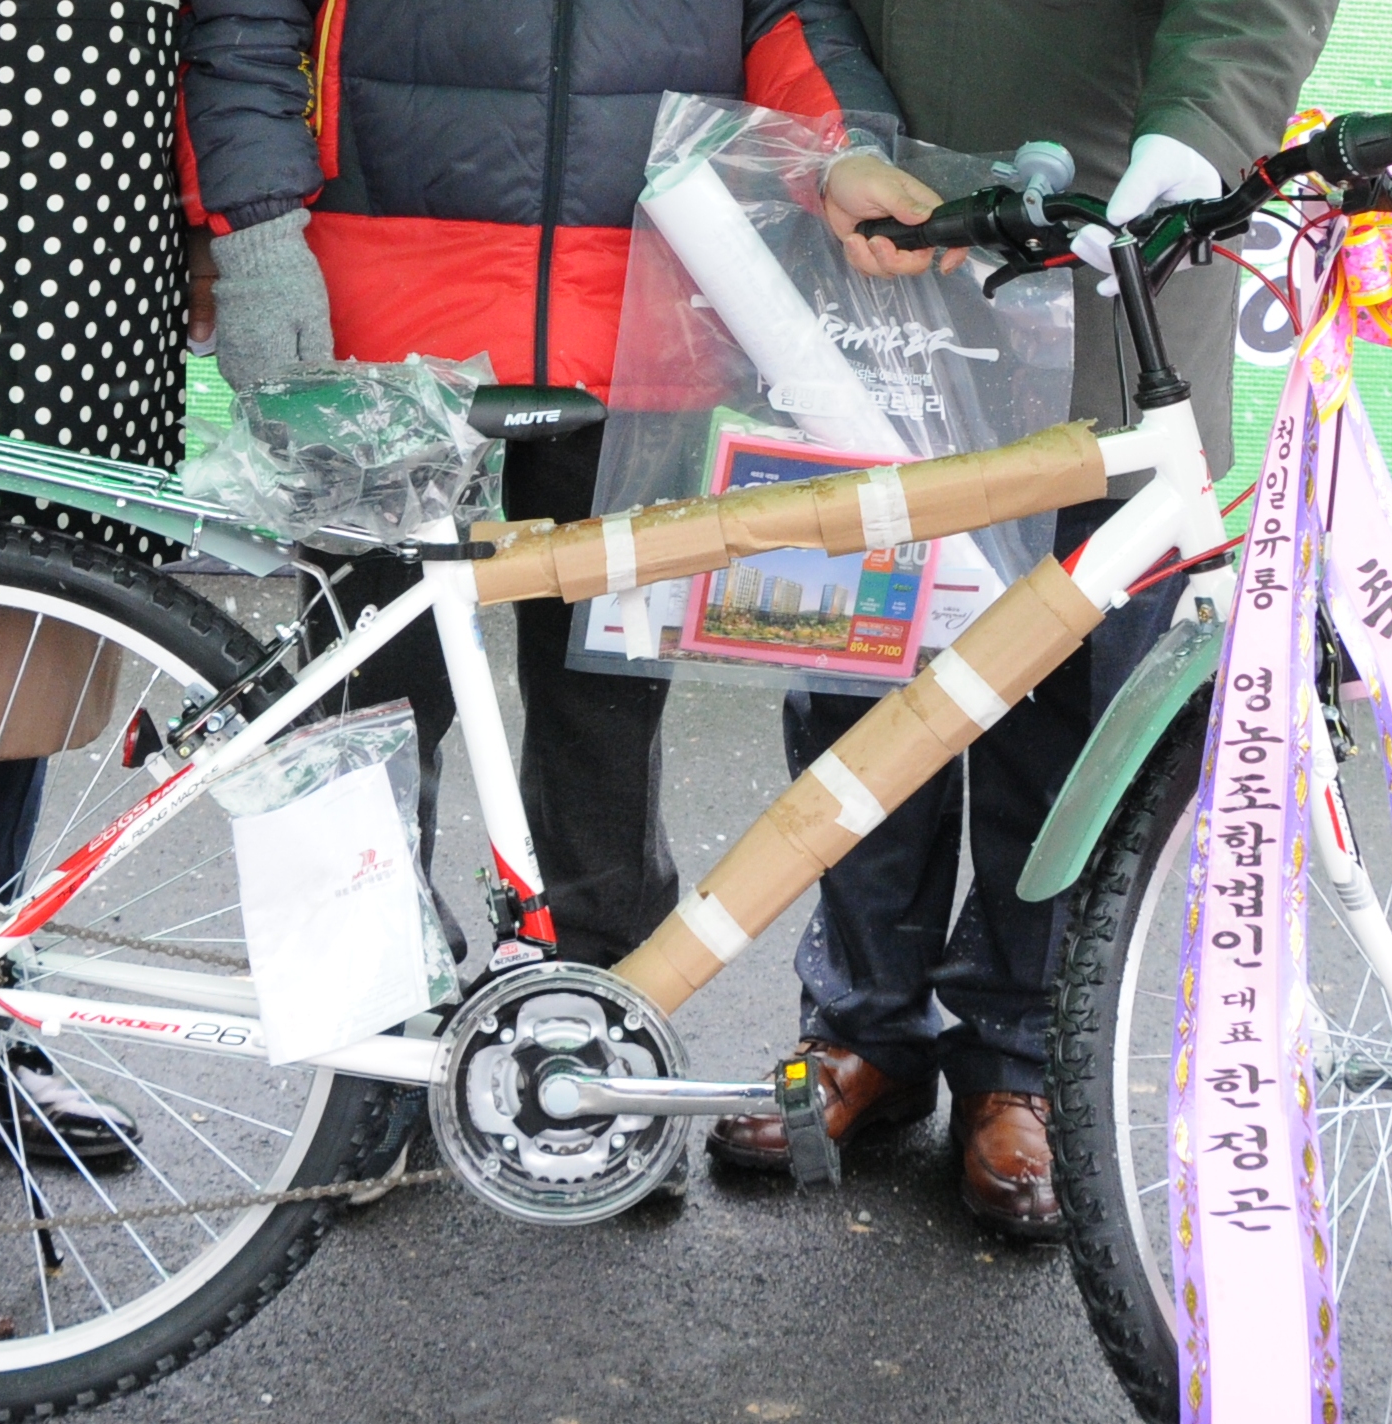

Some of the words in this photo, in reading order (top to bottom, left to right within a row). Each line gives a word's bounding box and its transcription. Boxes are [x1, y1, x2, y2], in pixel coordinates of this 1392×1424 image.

[504, 409, 562, 426] MUTE
[1246, 416, 1295, 610] 청일유통
[849, 641, 903, 657] 894-7100
[1211, 667, 1284, 968] 영농조합법인
[69, 1011, 181, 1033] KARDEN
[184, 1022, 252, 1046] 26
[1220, 987, 1262, 1044] 대표
[1203, 1063, 1291, 1232] 한정곤
